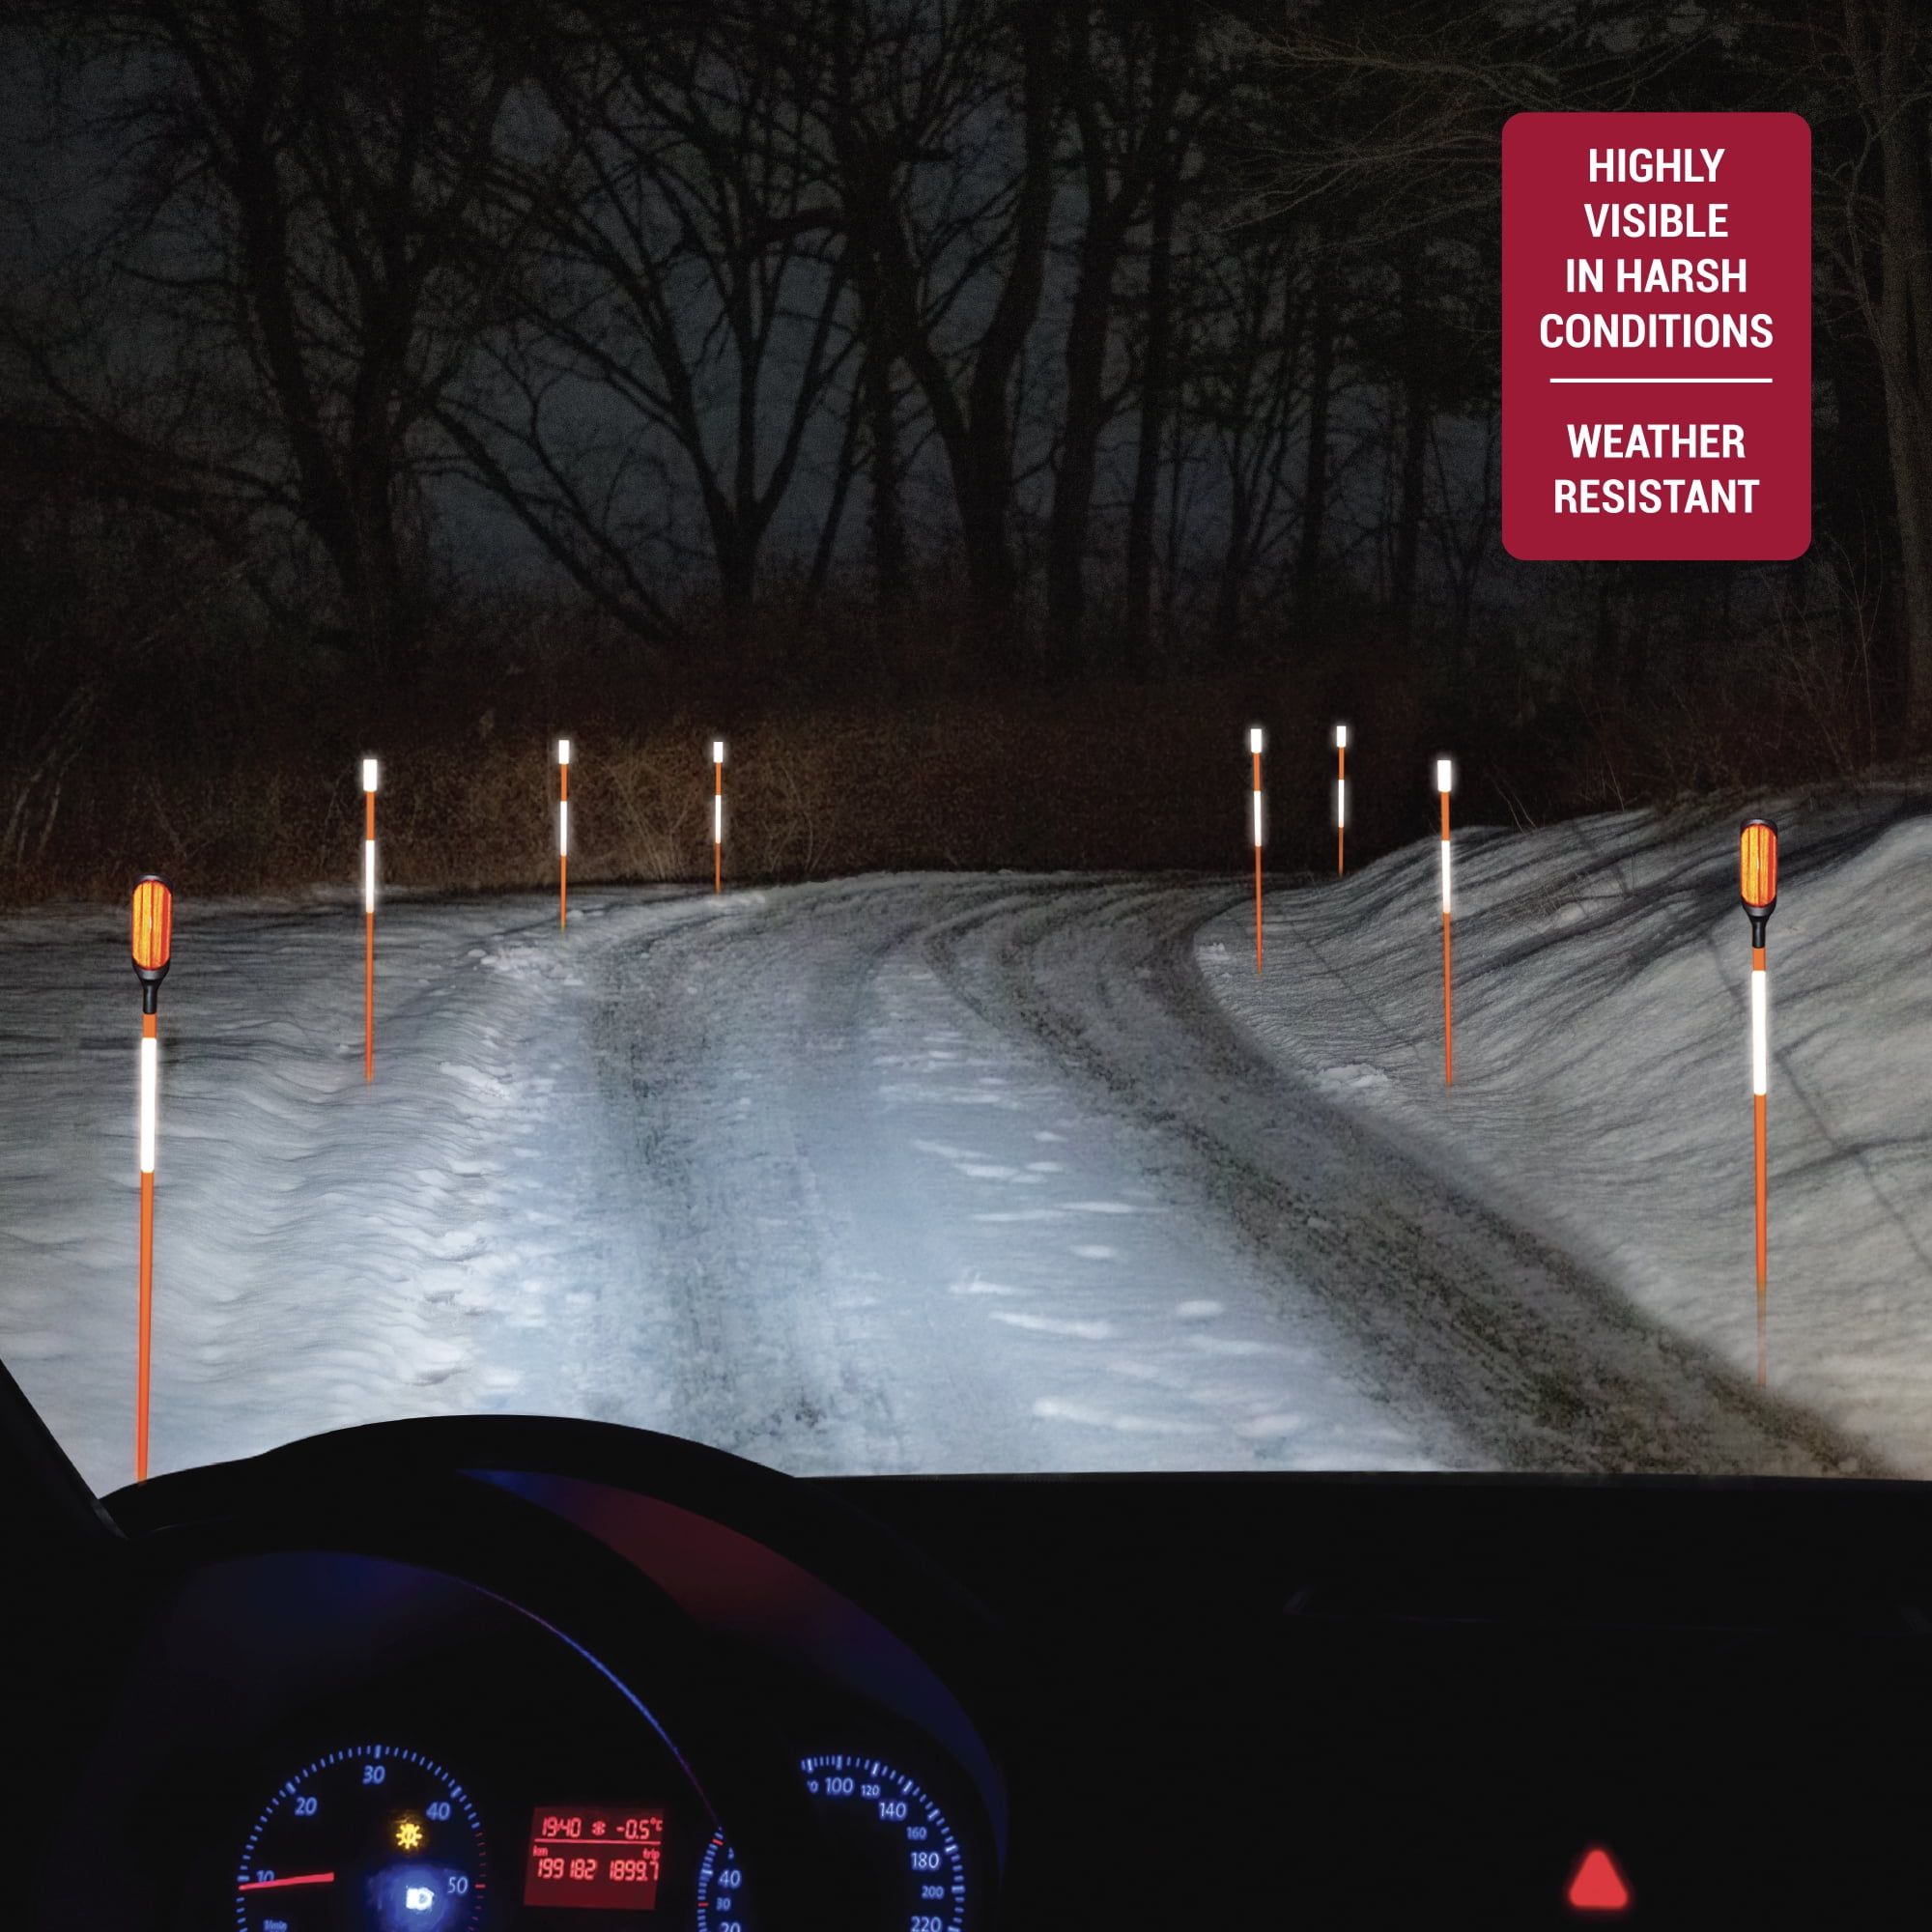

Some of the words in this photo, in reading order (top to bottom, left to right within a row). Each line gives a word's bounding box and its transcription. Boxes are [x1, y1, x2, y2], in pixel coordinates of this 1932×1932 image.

[362, 1766, 385, 1784] 30
[825, 1777, 854, 1795] 100
[861, 1785, 880, 1798] 120
[295, 1798, 317, 1816] 20
[426, 1802, 450, 1821] 40
[879, 1803, 906, 1821] 140
[907, 1827, 926, 1840] 160
[537, 1858, 564, 1879] 199
[569, 1859, 597, 1880] 182
[911, 1852, 940, 1870] 180
[447, 1877, 469, 1894] 50
[719, 1870, 740, 1888] 40
[922, 1886, 944, 1899] 200
[911, 1917, 941, 1932] 220
